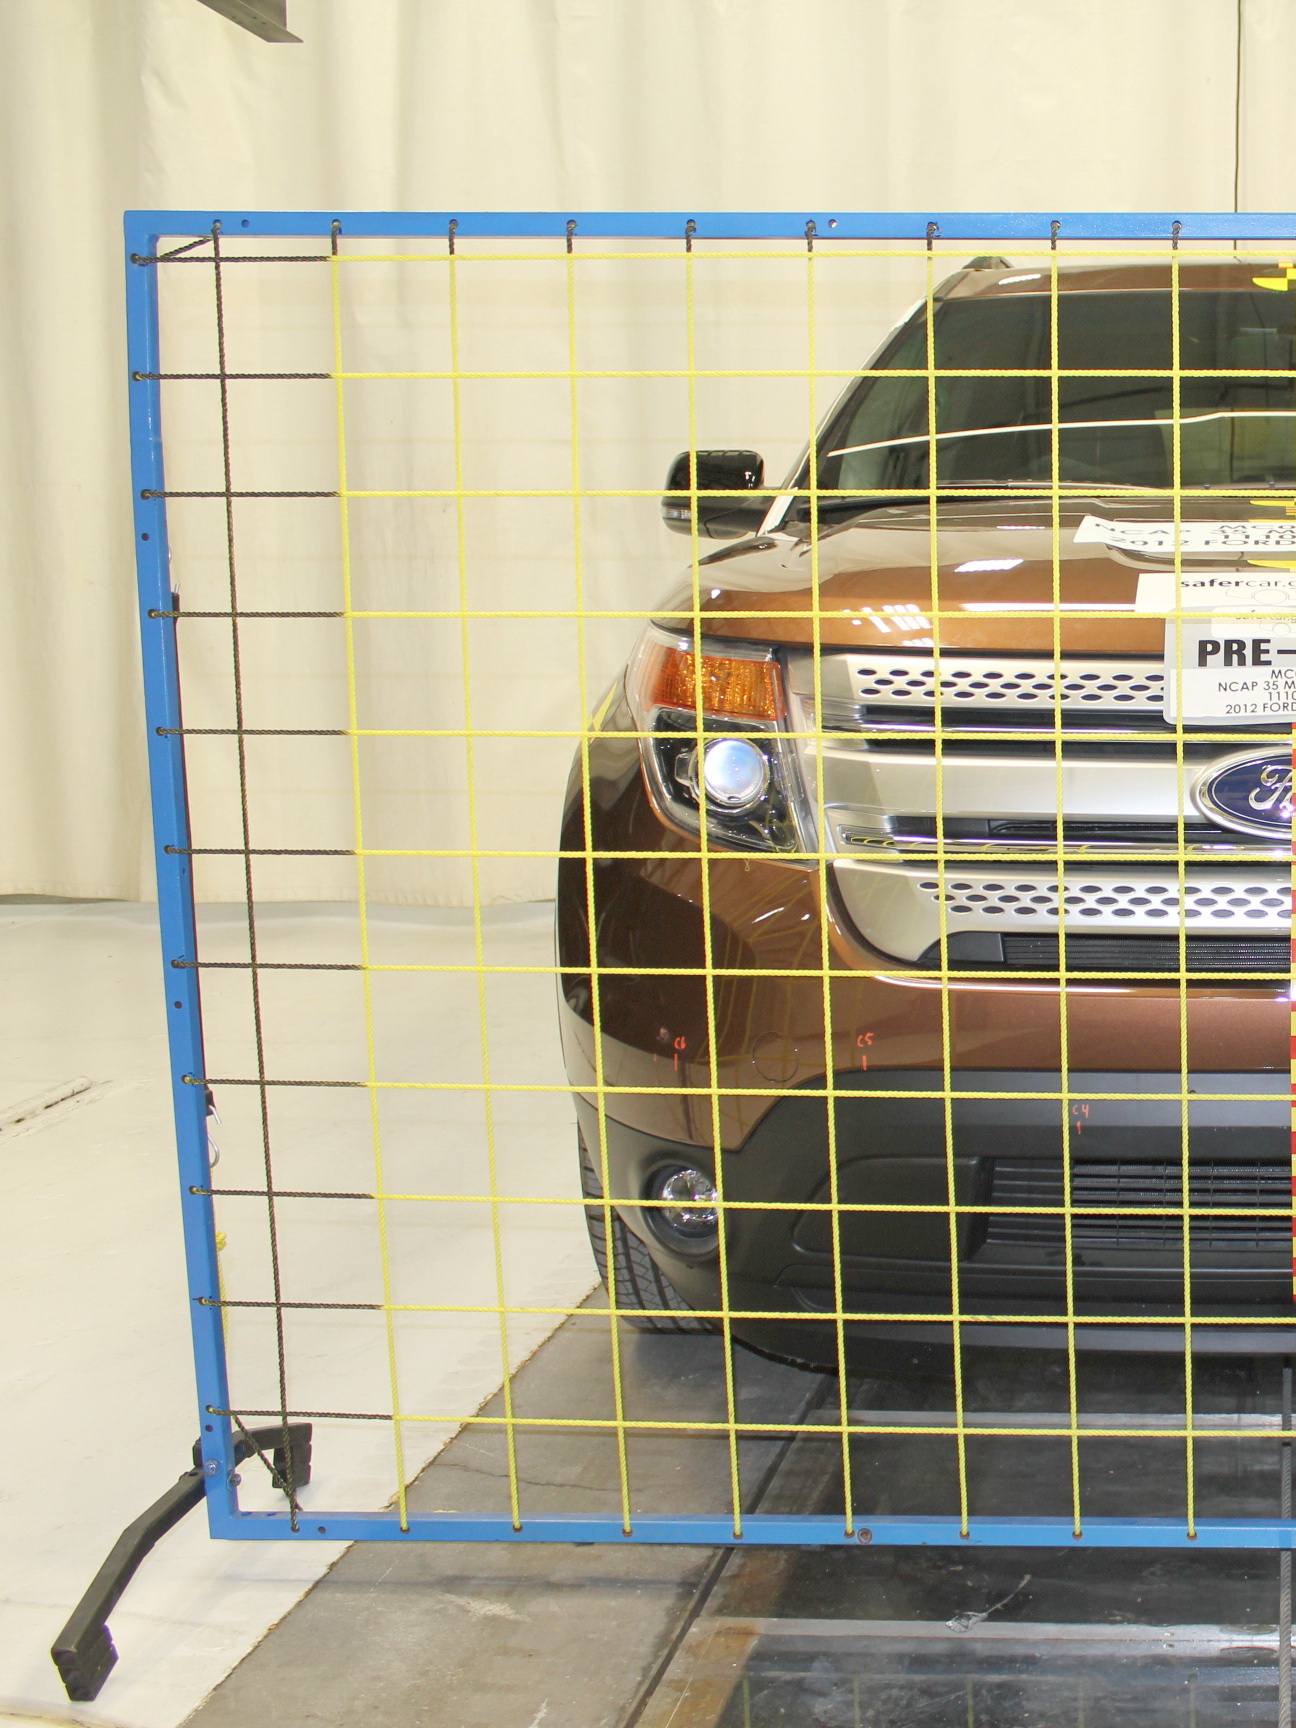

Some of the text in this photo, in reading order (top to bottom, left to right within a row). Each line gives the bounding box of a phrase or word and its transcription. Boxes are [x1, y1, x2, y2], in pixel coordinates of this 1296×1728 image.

[1109, 536, 1190, 546] 2012
[1218, 681, 1258, 692] NCAP
[1263, 681, 1279, 691] 35
[1225, 704, 1258, 714] 2012
